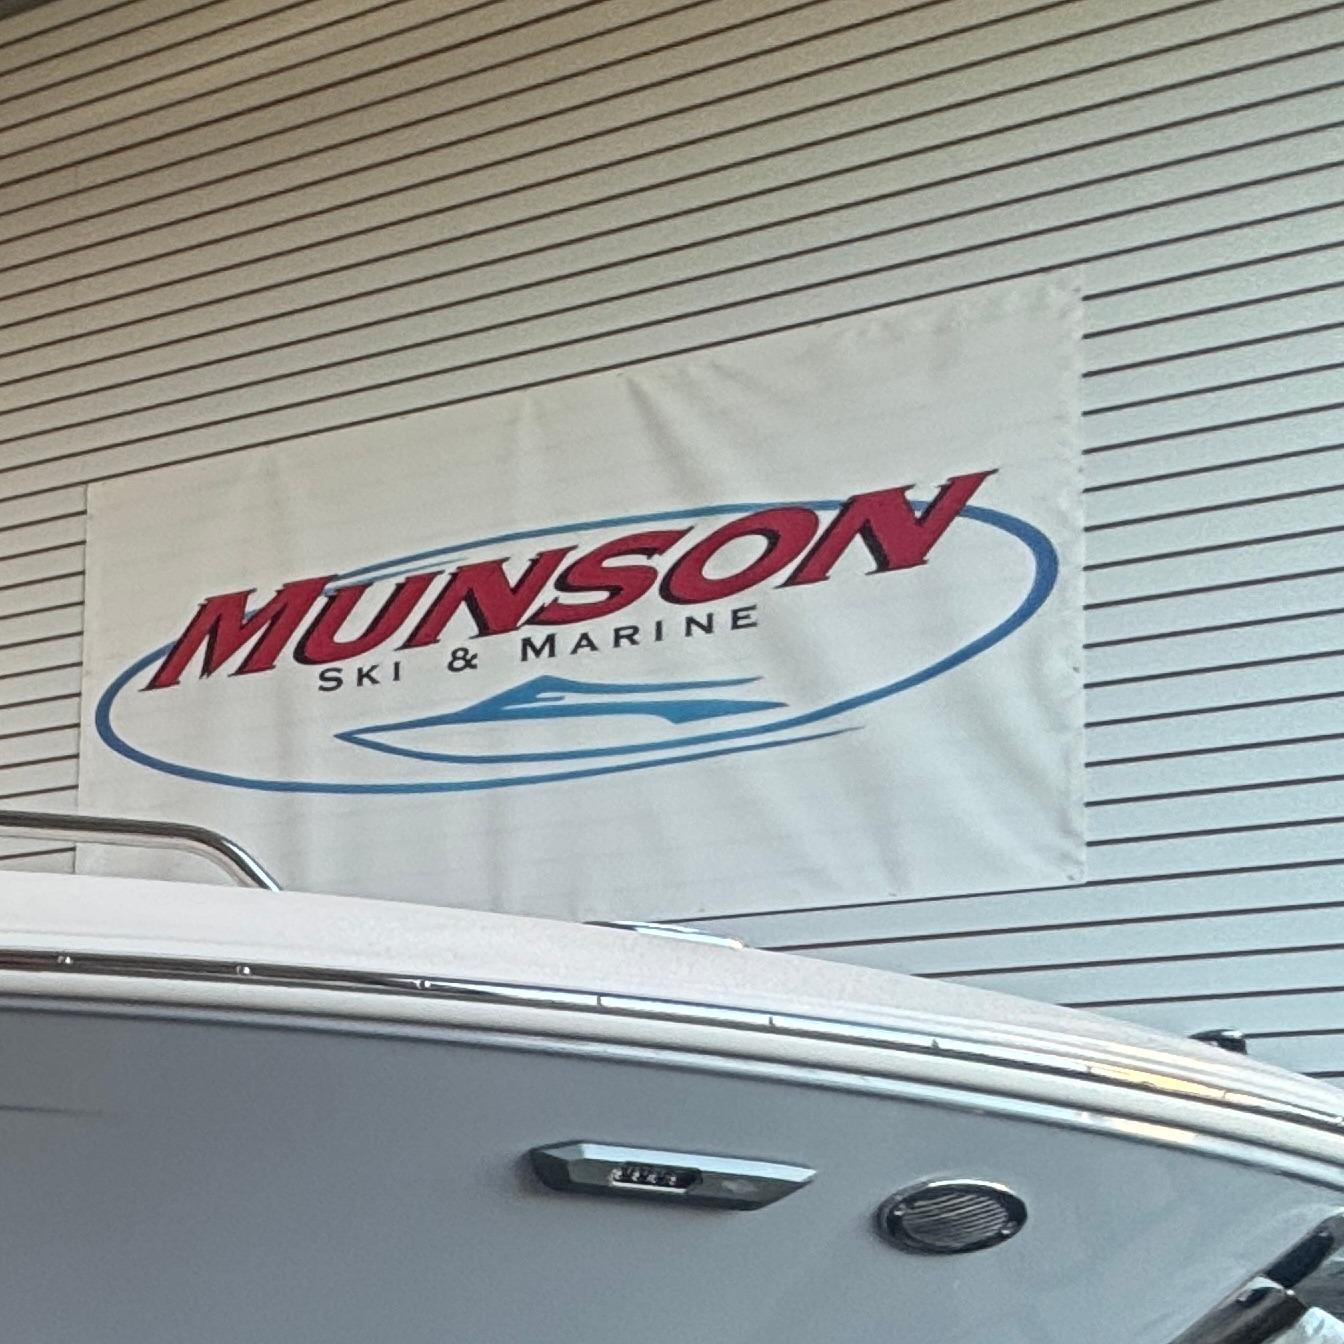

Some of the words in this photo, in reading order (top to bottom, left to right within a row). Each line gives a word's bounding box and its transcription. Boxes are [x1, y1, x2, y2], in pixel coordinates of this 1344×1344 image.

[144, 469, 999, 691] MUNSON
[318, 661, 401, 692] SKI
[447, 647, 478, 673] &
[519, 604, 759, 663] MARINE
